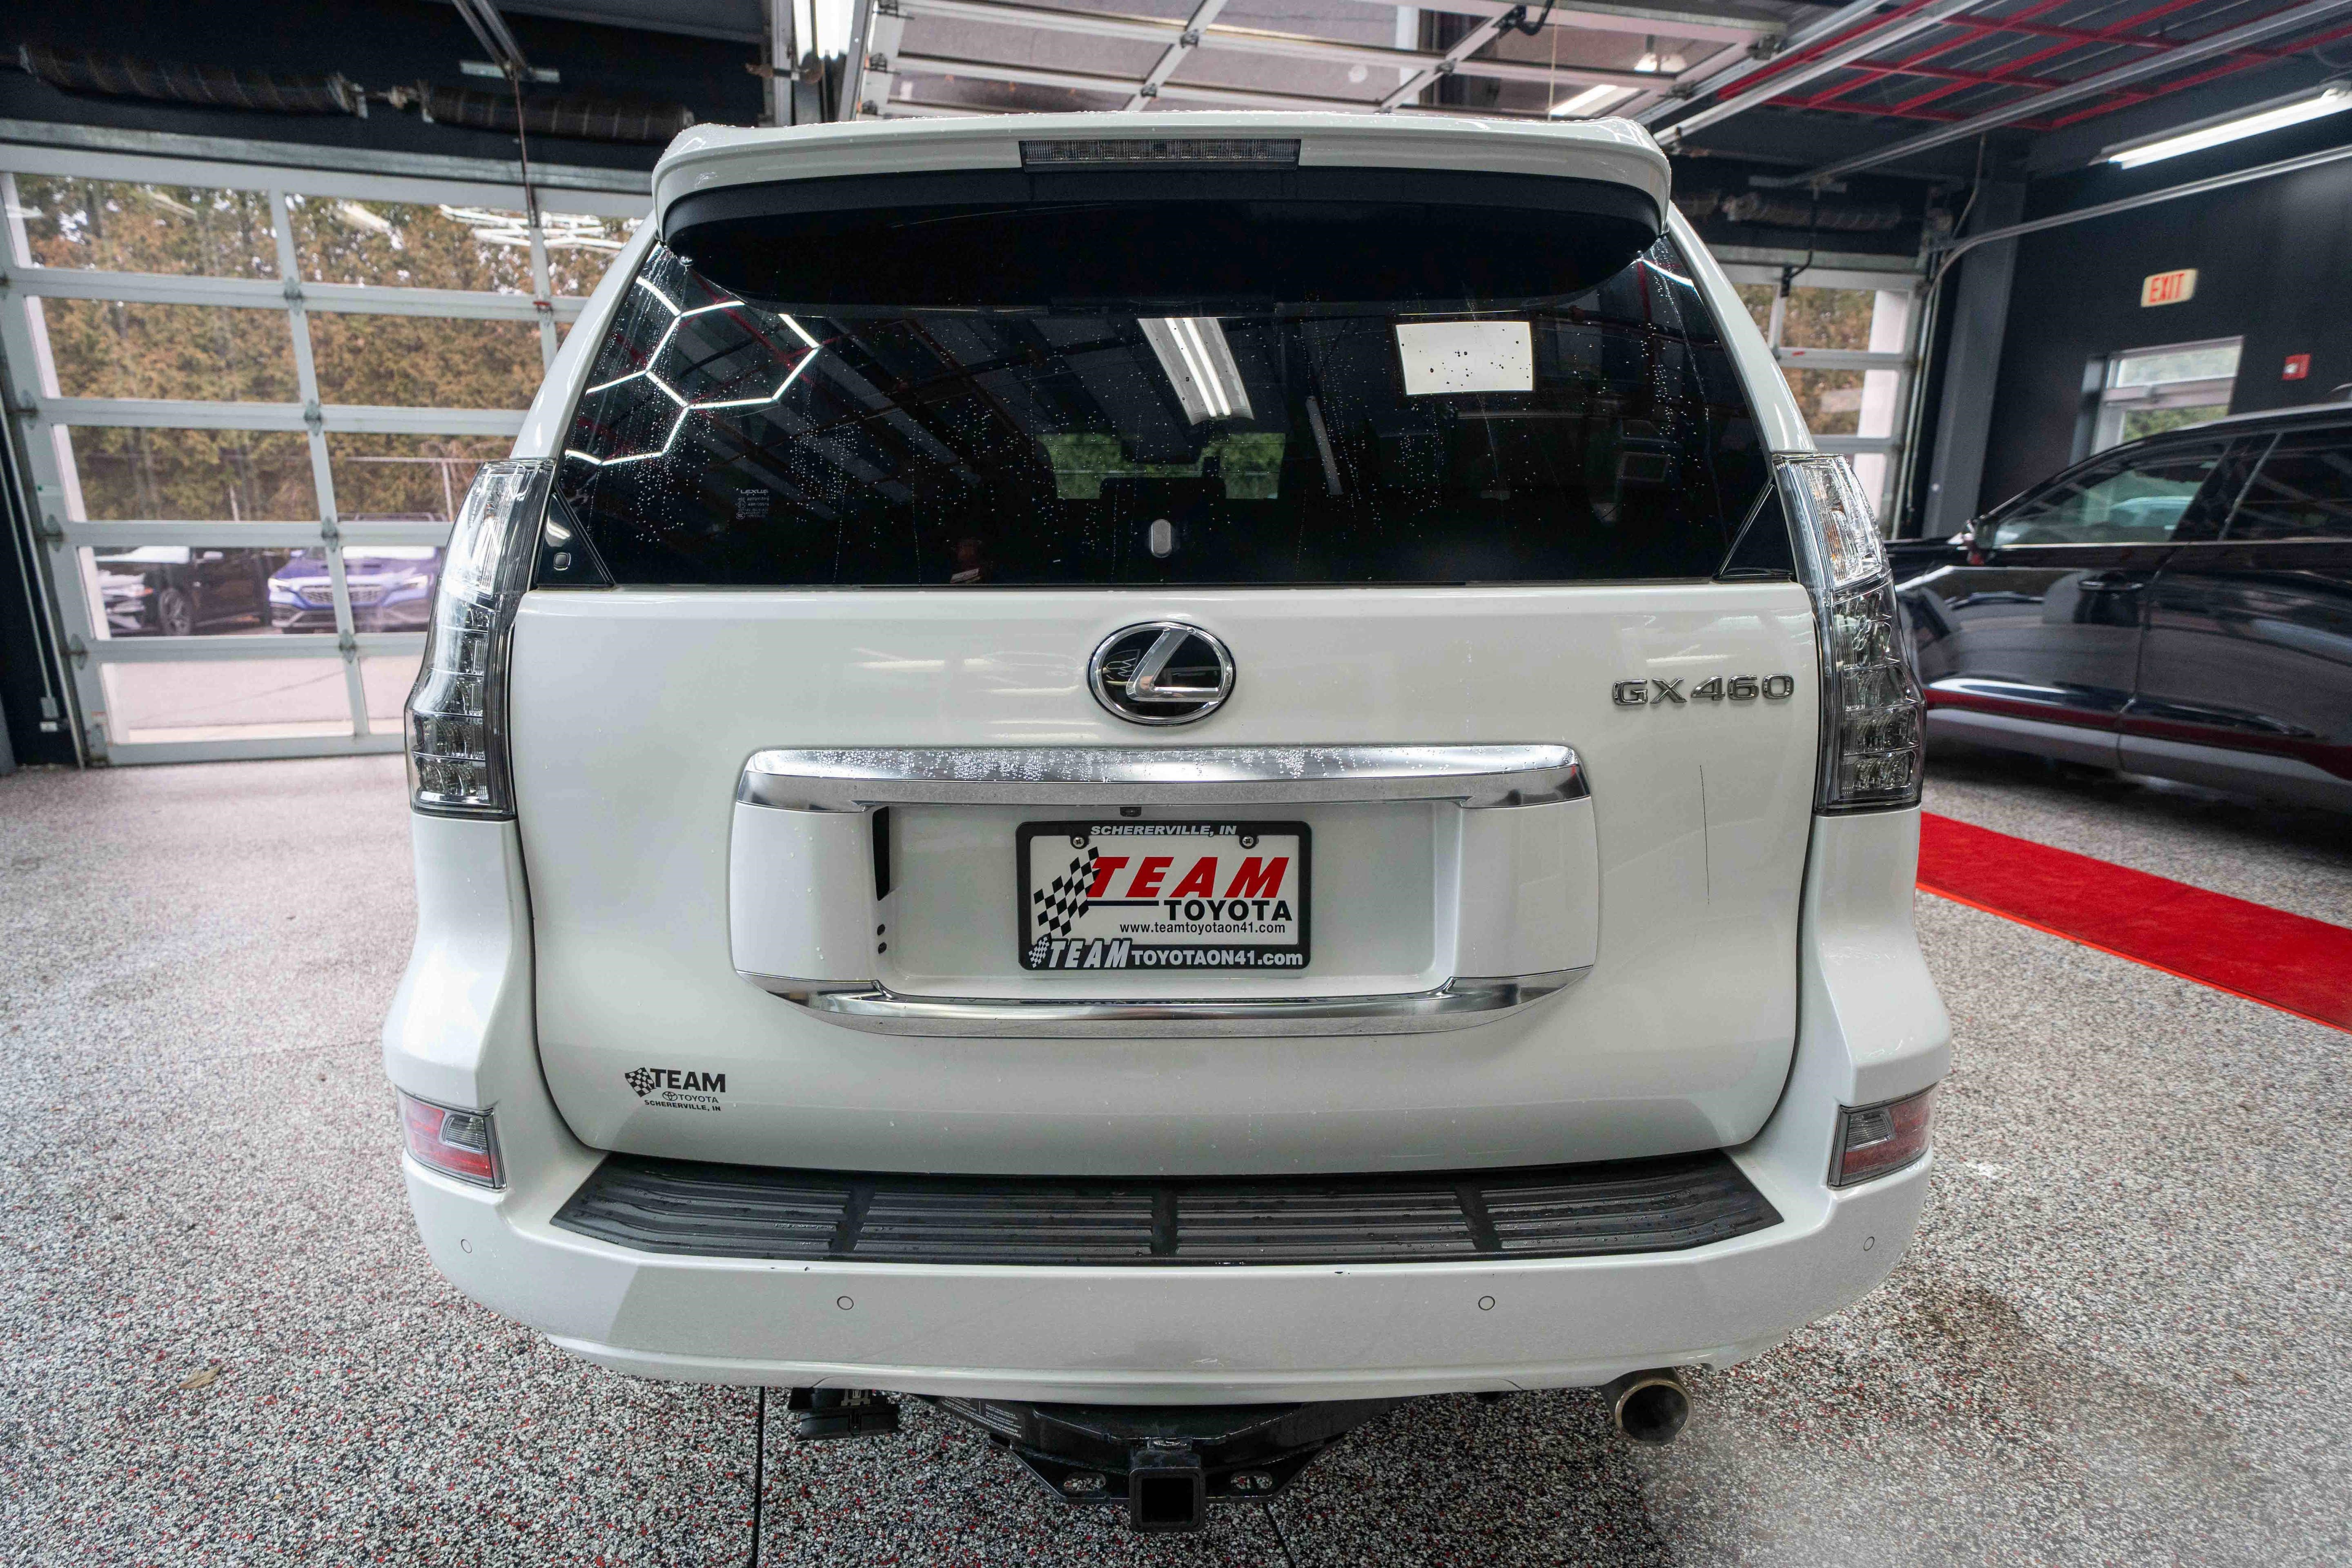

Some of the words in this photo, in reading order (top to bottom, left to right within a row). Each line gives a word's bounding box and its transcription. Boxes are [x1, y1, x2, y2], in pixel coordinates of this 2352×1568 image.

[2149, 272, 2185, 303] EXIT
[1091, 825, 1214, 837] SCHERERVILLE,
[1219, 825, 1237, 835] IN
[1086, 857, 1290, 898] TEAM
[1164, 900, 1292, 921] TOYOTA
[1120, 922, 1285, 934] www.teamtoyotaon41.com
[650, 1068, 726, 1093] TEAM
[644, 1100, 710, 1111] SCHERERVILLE,
[677, 1094, 719, 1103] TOYOTA
